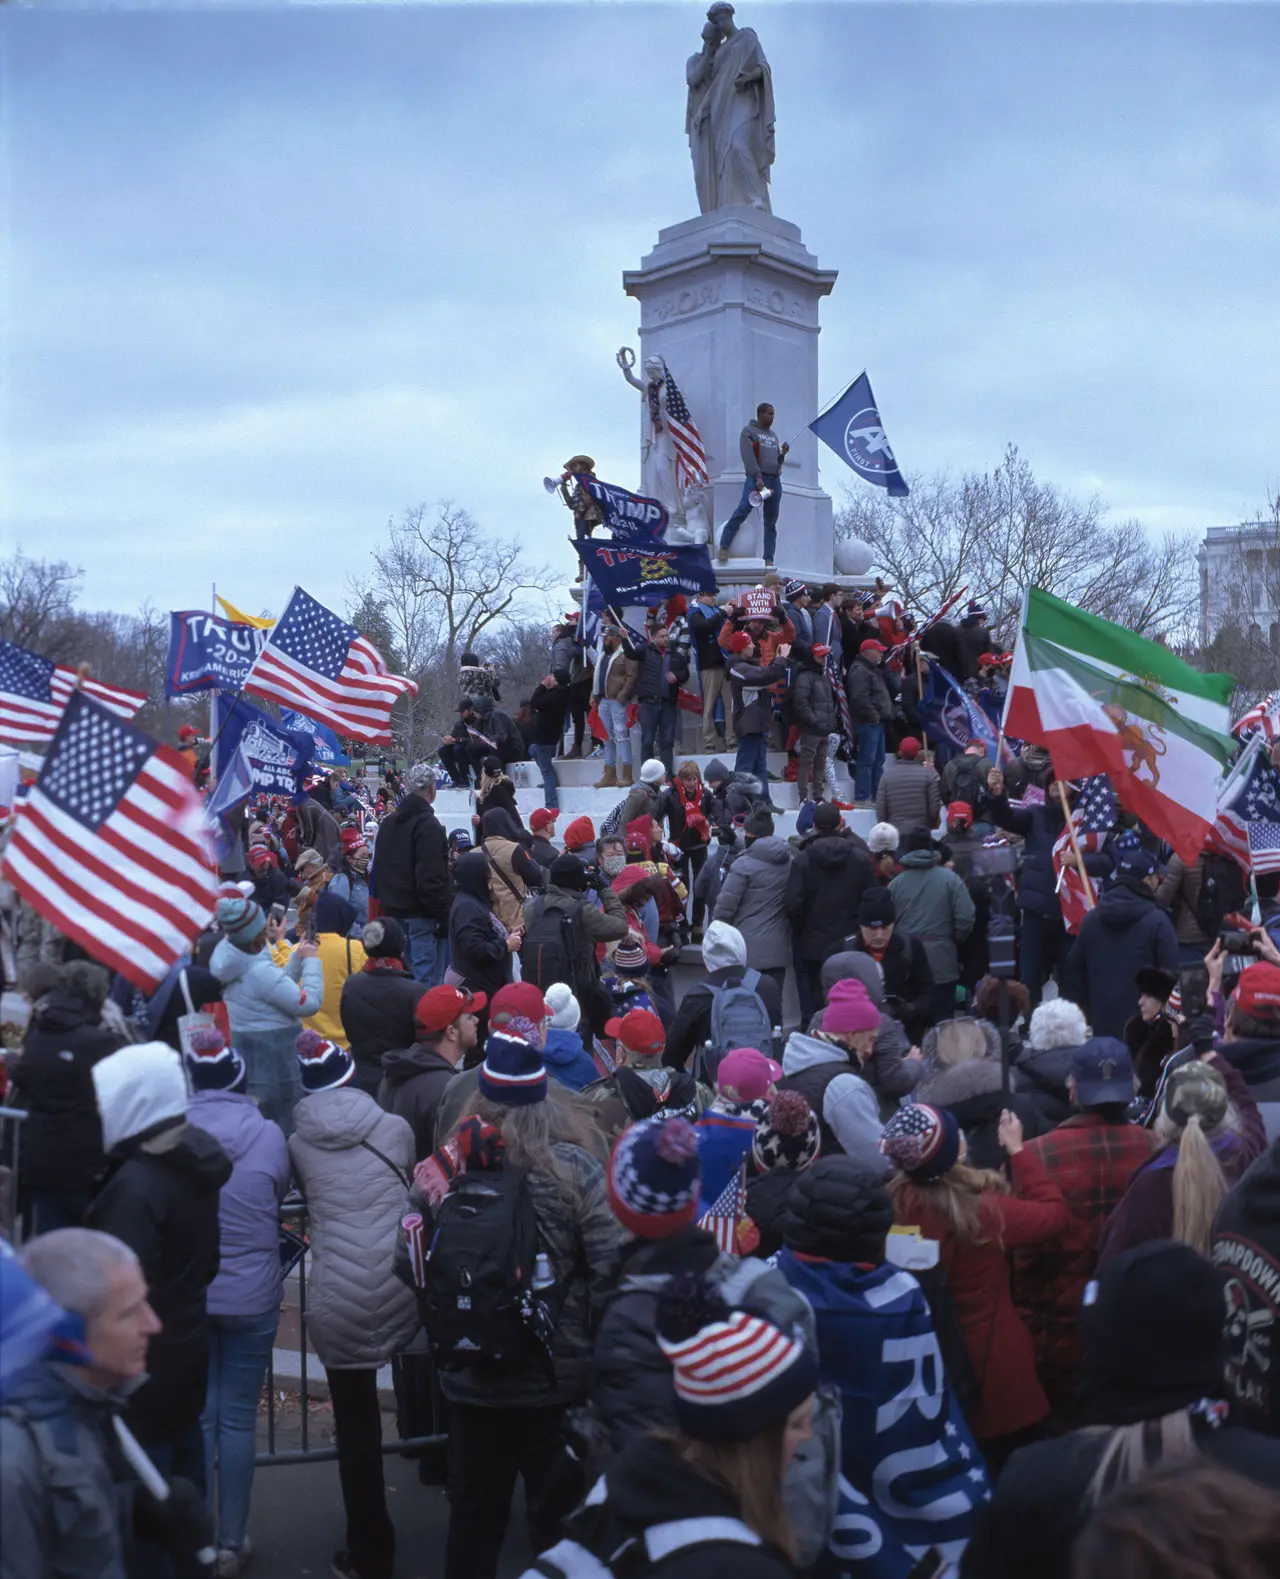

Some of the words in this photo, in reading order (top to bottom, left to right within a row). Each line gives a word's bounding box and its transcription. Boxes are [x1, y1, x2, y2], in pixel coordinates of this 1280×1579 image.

[850, 449, 869, 467] FIRST
[187, 615, 266, 655] TRU
[204, 662, 250, 678] AMERIC
[263, 764, 275, 773] ALL
